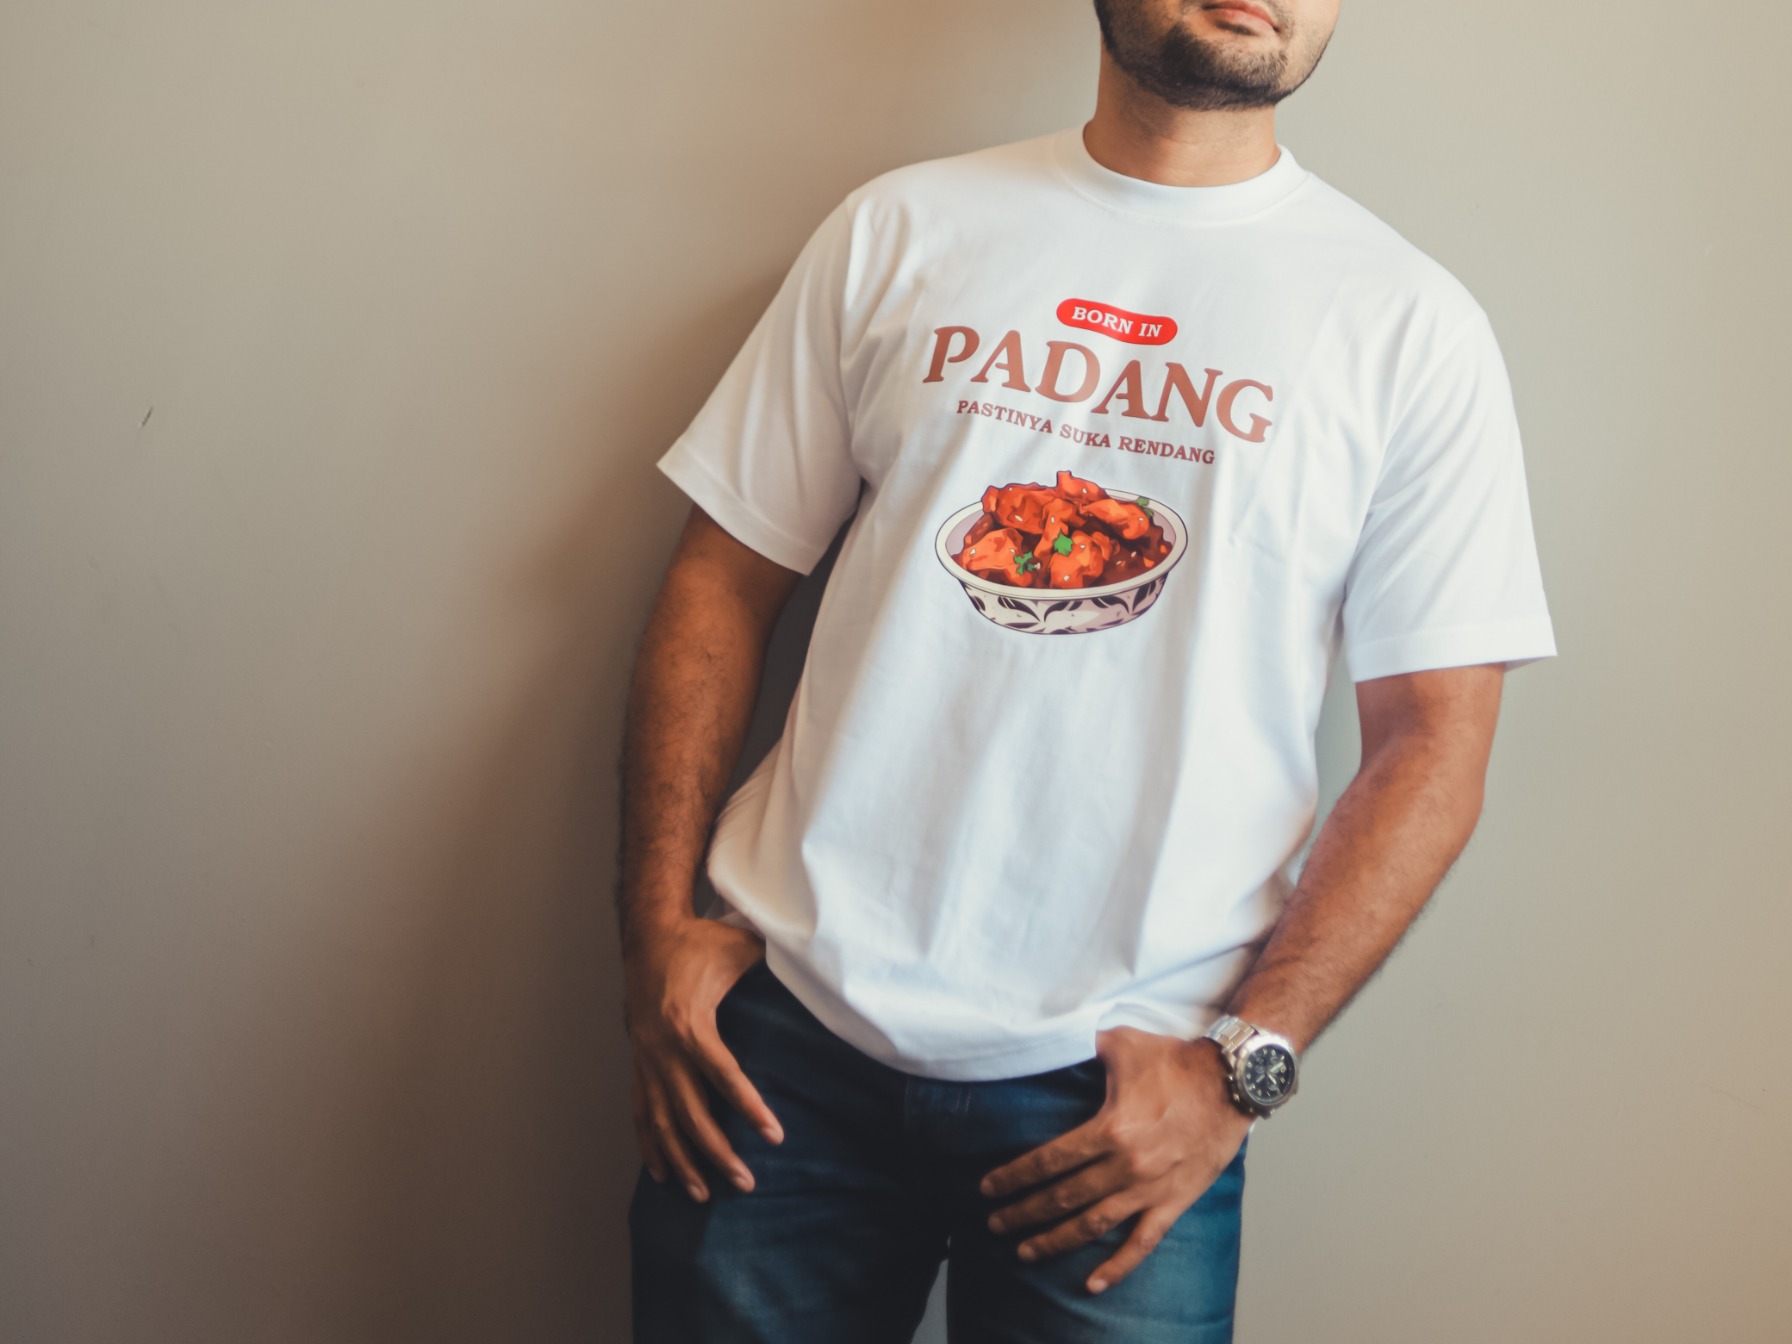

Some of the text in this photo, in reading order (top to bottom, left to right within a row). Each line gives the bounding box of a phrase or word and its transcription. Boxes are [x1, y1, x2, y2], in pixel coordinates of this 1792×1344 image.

[1072, 306, 1162, 337] BORN IN
[922, 325, 1274, 443] PADANG
[956, 400, 1215, 465] PASTINYA SUKA RENDANG
